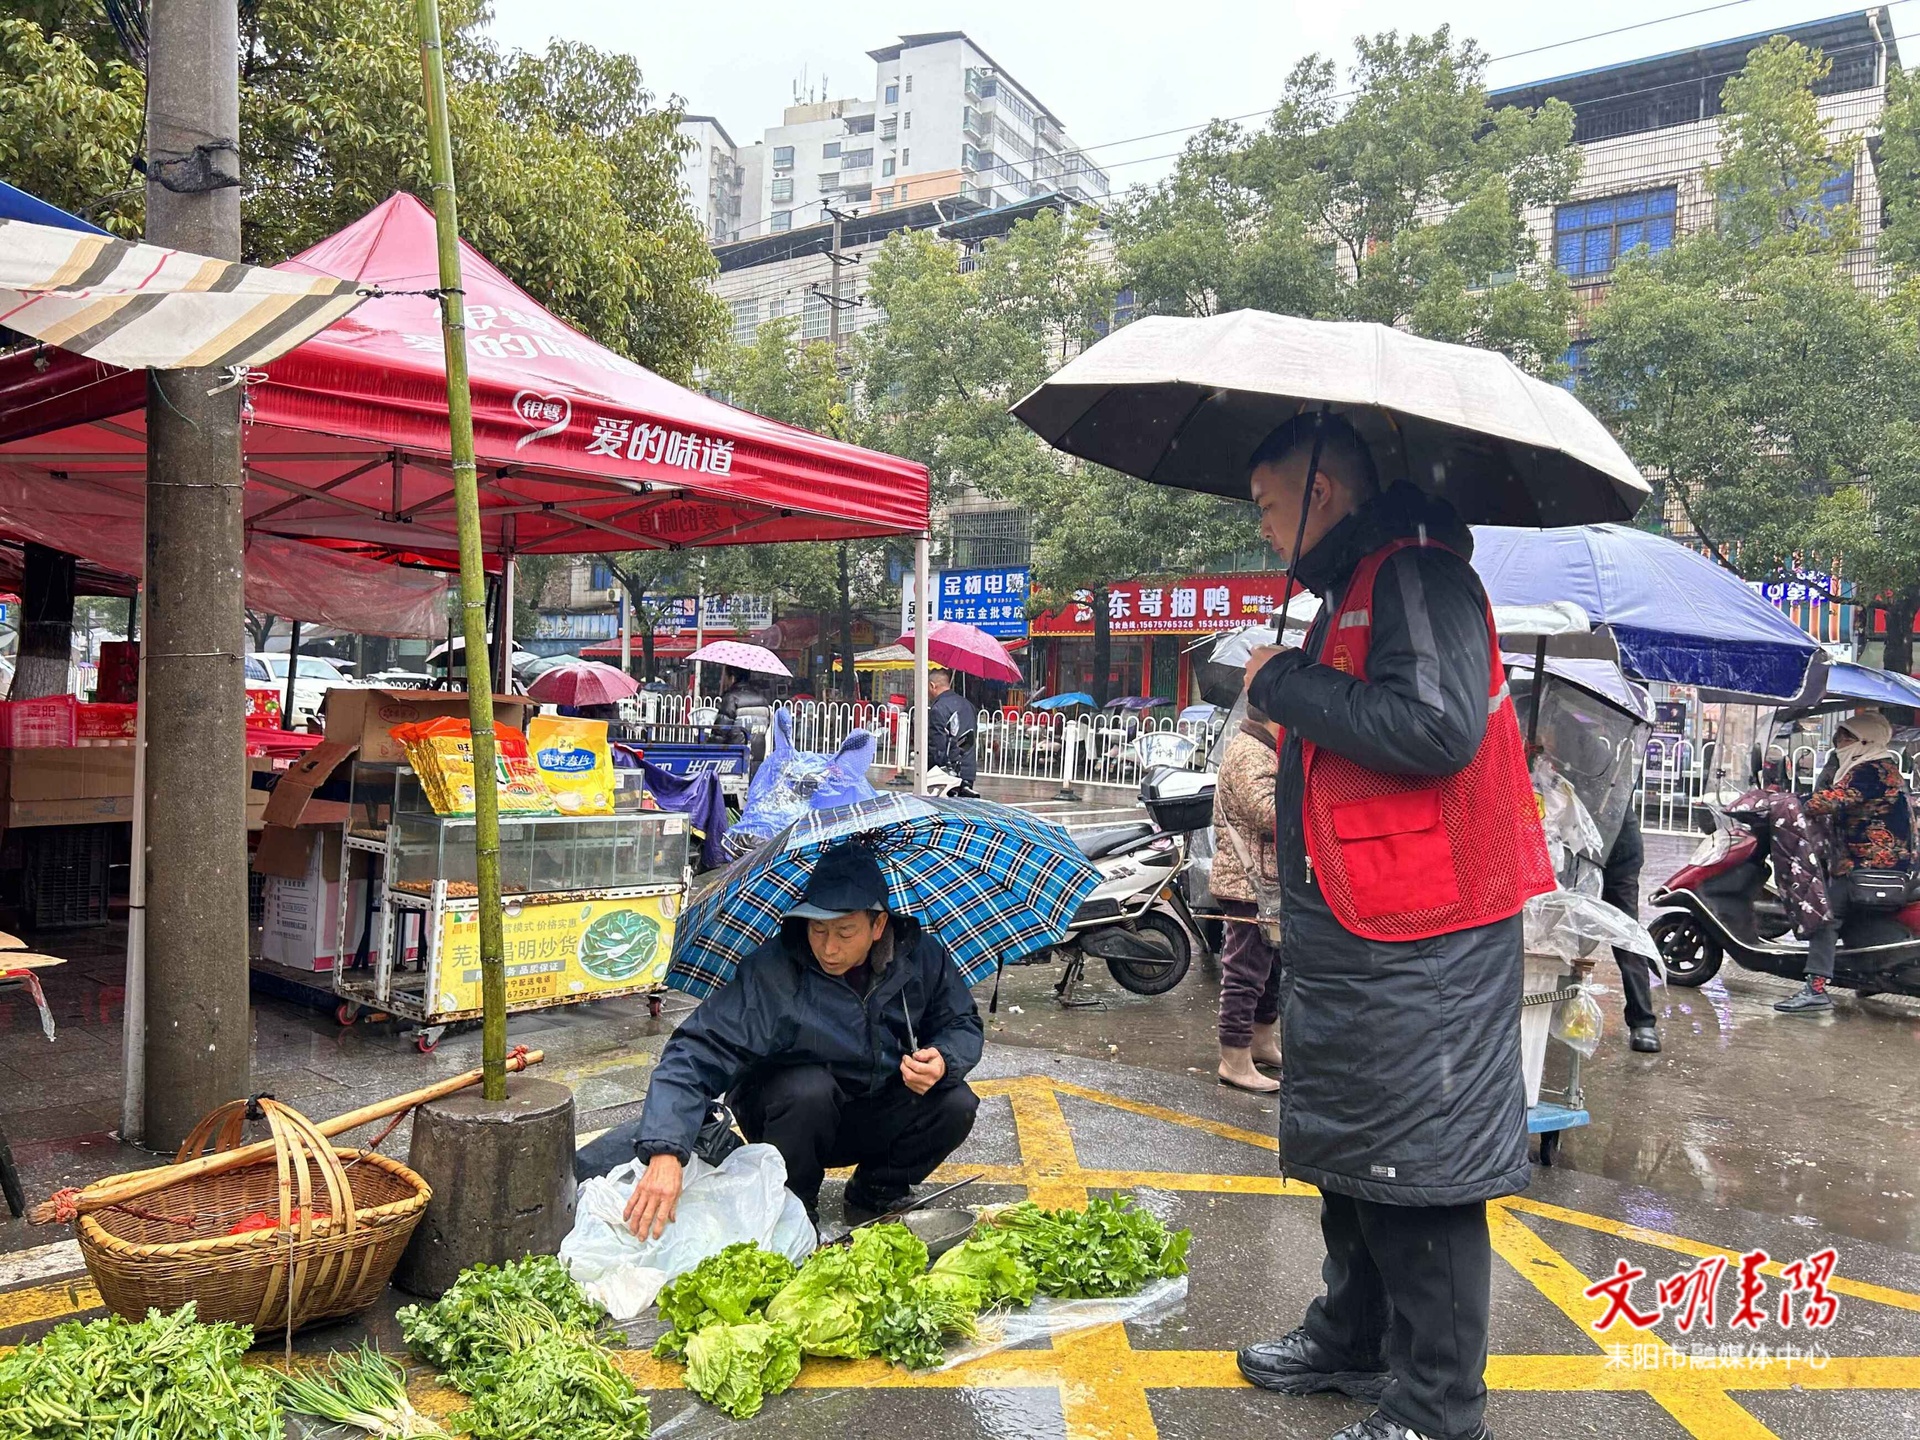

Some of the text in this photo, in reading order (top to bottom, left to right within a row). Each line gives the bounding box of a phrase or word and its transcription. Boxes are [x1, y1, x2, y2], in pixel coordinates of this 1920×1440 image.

[585, 416, 734, 477] 爱的味道
[943, 606, 1023, 620] 灶市五金批零店
[1108, 586, 1230, 618] 东哥捆鸭
[685, 760, 737, 774] 出口版
[536, 918, 577, 932] 价格实惠
[452, 935, 577, 968] 芜昌明炒货
